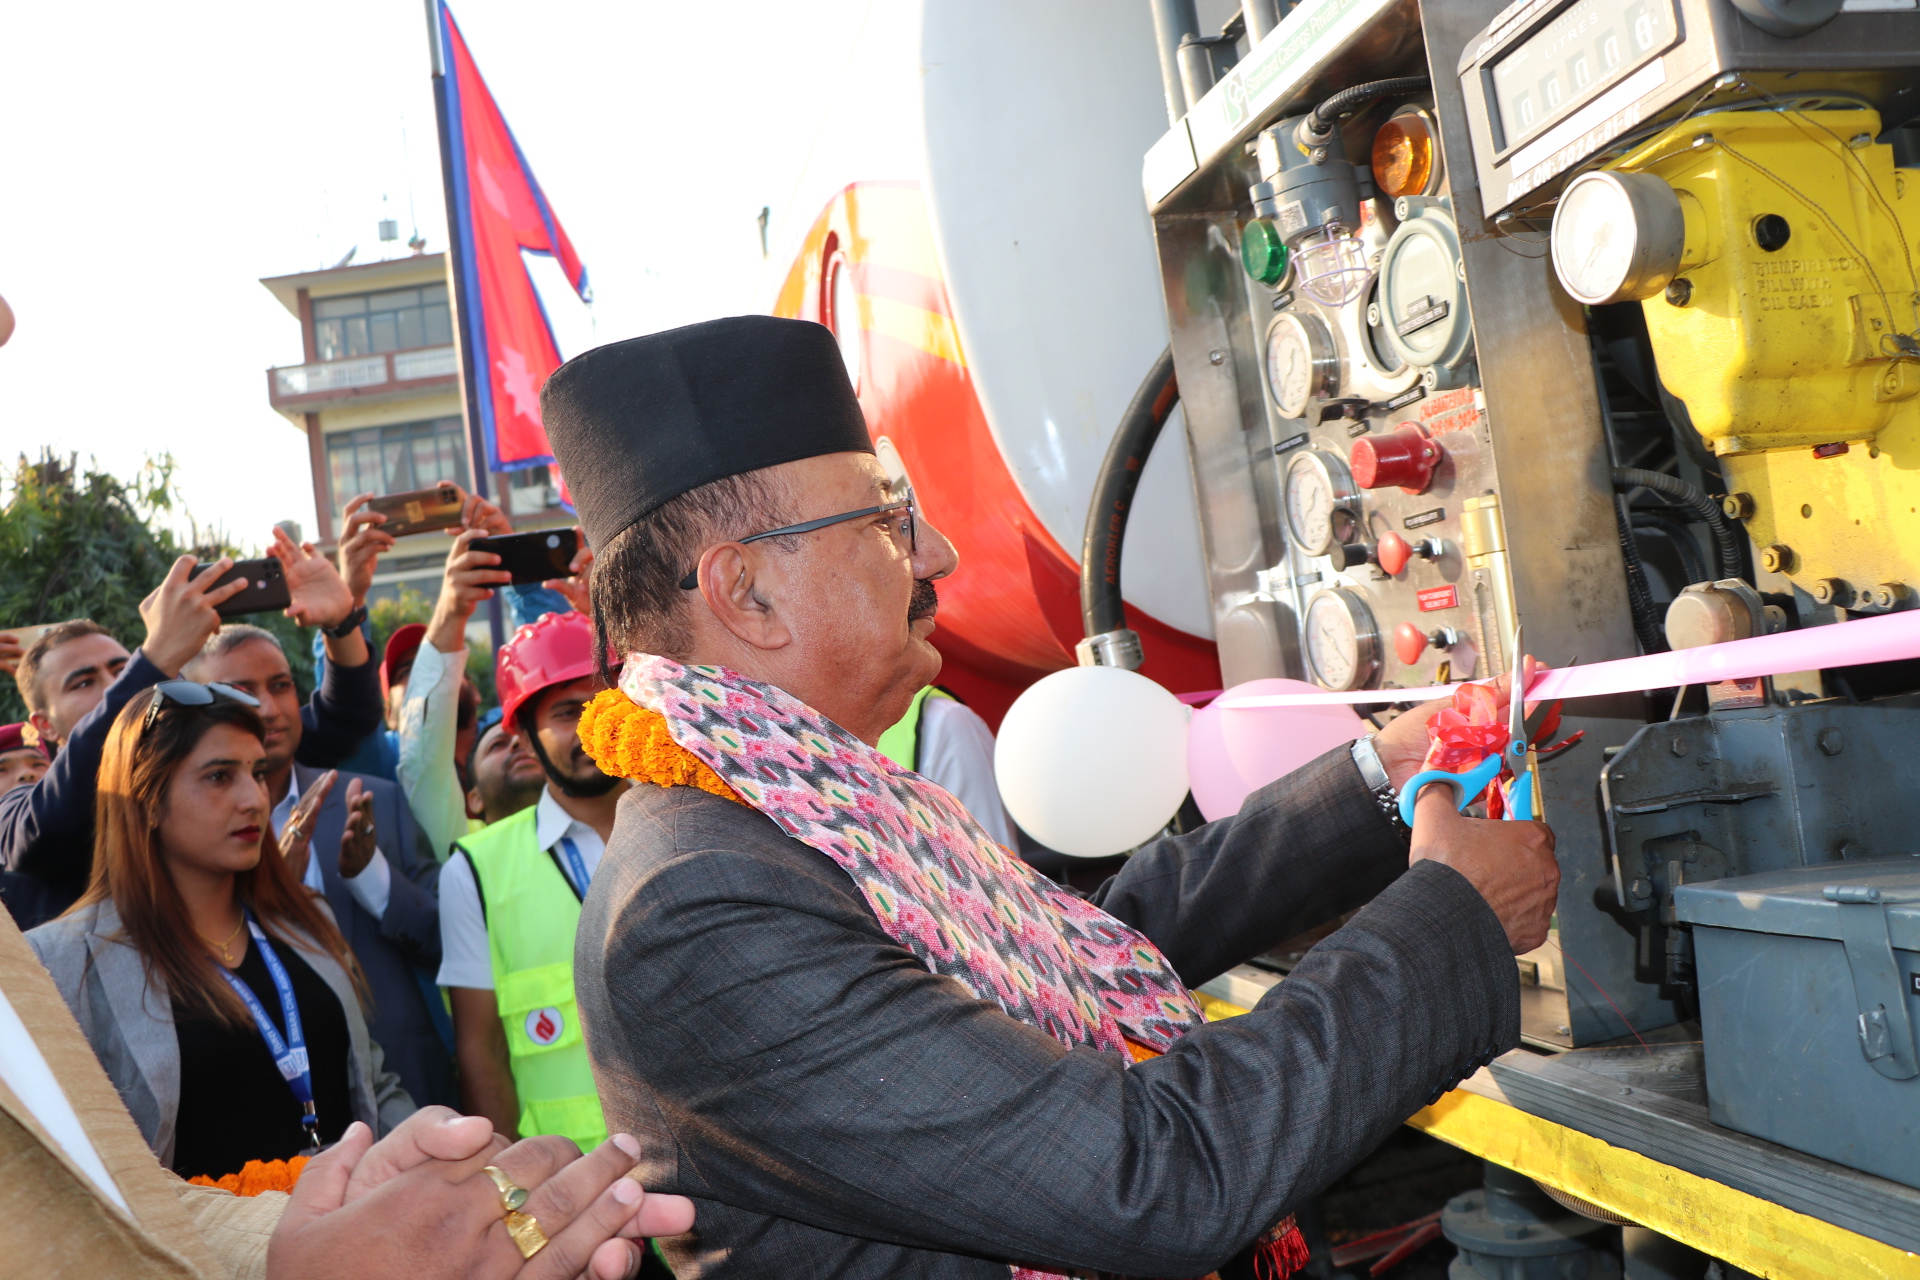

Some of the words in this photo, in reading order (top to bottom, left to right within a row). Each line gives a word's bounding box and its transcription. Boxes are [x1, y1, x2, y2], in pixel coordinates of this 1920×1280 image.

[1476, 6, 1533, 59] CALIBRATED
[1544, 12, 1599, 60] LITRES
[1507, 173, 1532, 203] DUE
[1760, 297, 1785, 311] OIL
[1787, 294, 1820, 311] SAE
[1105, 513, 1123, 585] AEROKLER
